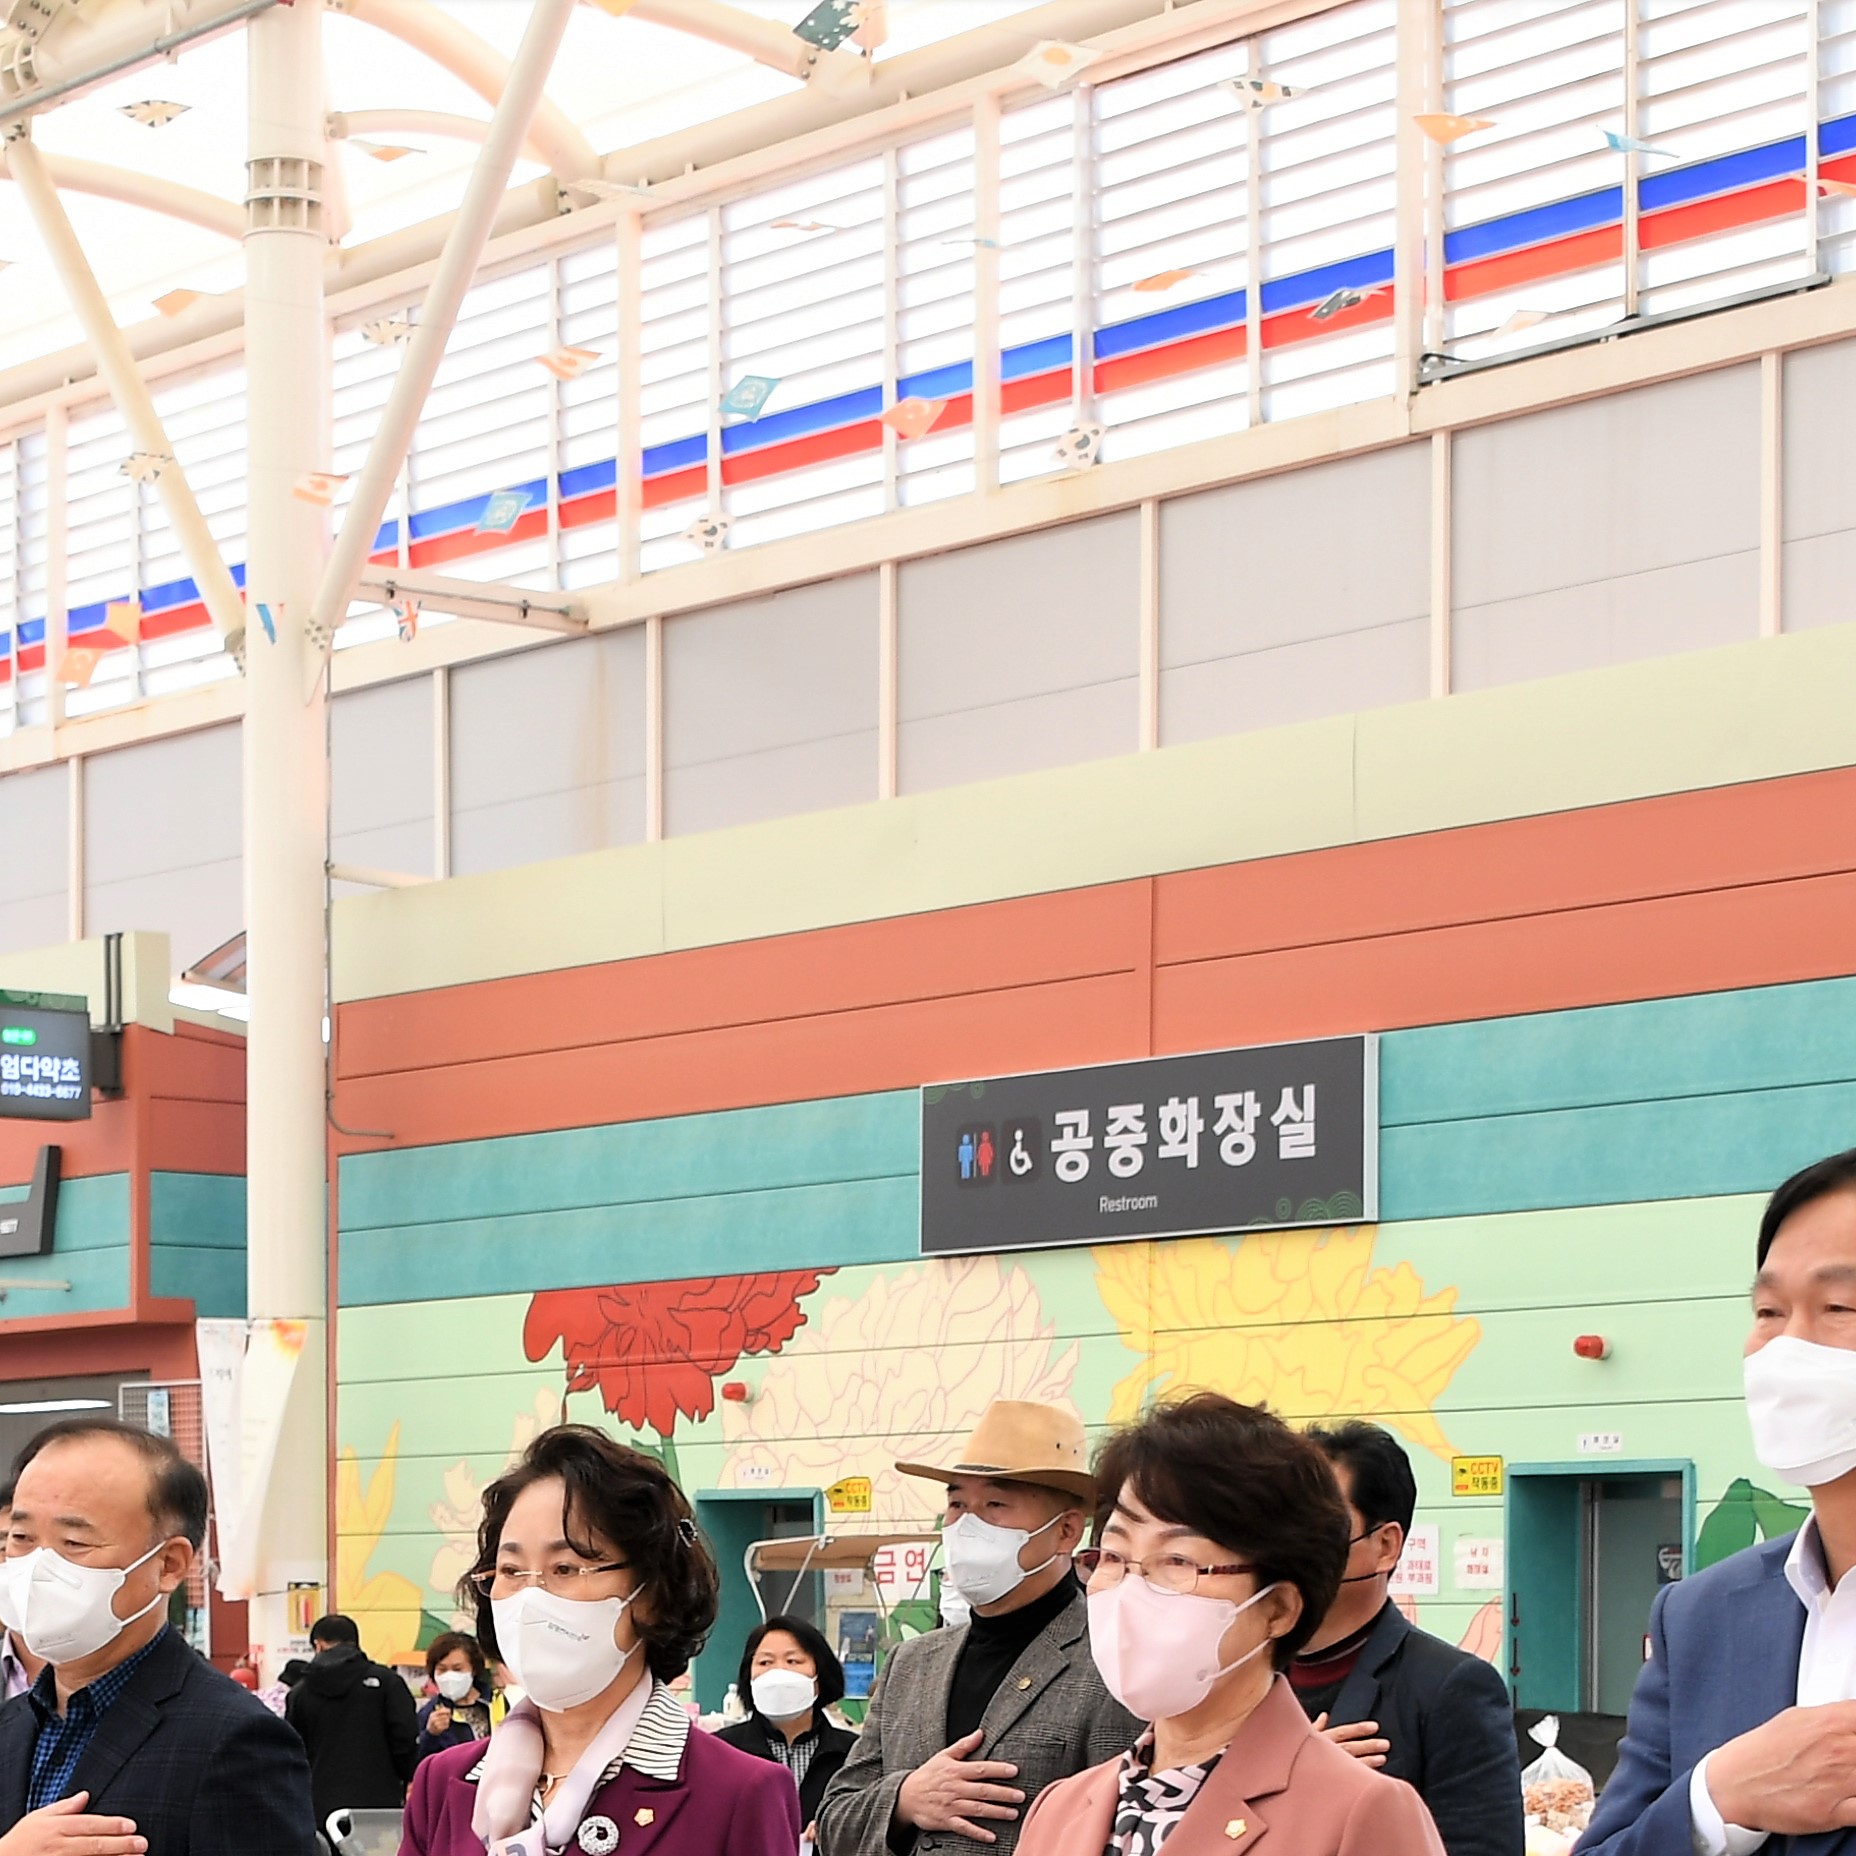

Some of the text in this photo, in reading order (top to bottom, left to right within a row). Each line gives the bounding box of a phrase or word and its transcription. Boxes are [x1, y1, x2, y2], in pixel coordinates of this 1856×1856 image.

[0, 1054, 81, 1083] 엄다약초
[1050, 1084, 1317, 1184] 공중화장실
[1098, 1194, 1159, 1214] Restroom
[1470, 1462, 1498, 1475] CCTV
[875, 1547, 926, 1585] 금연
